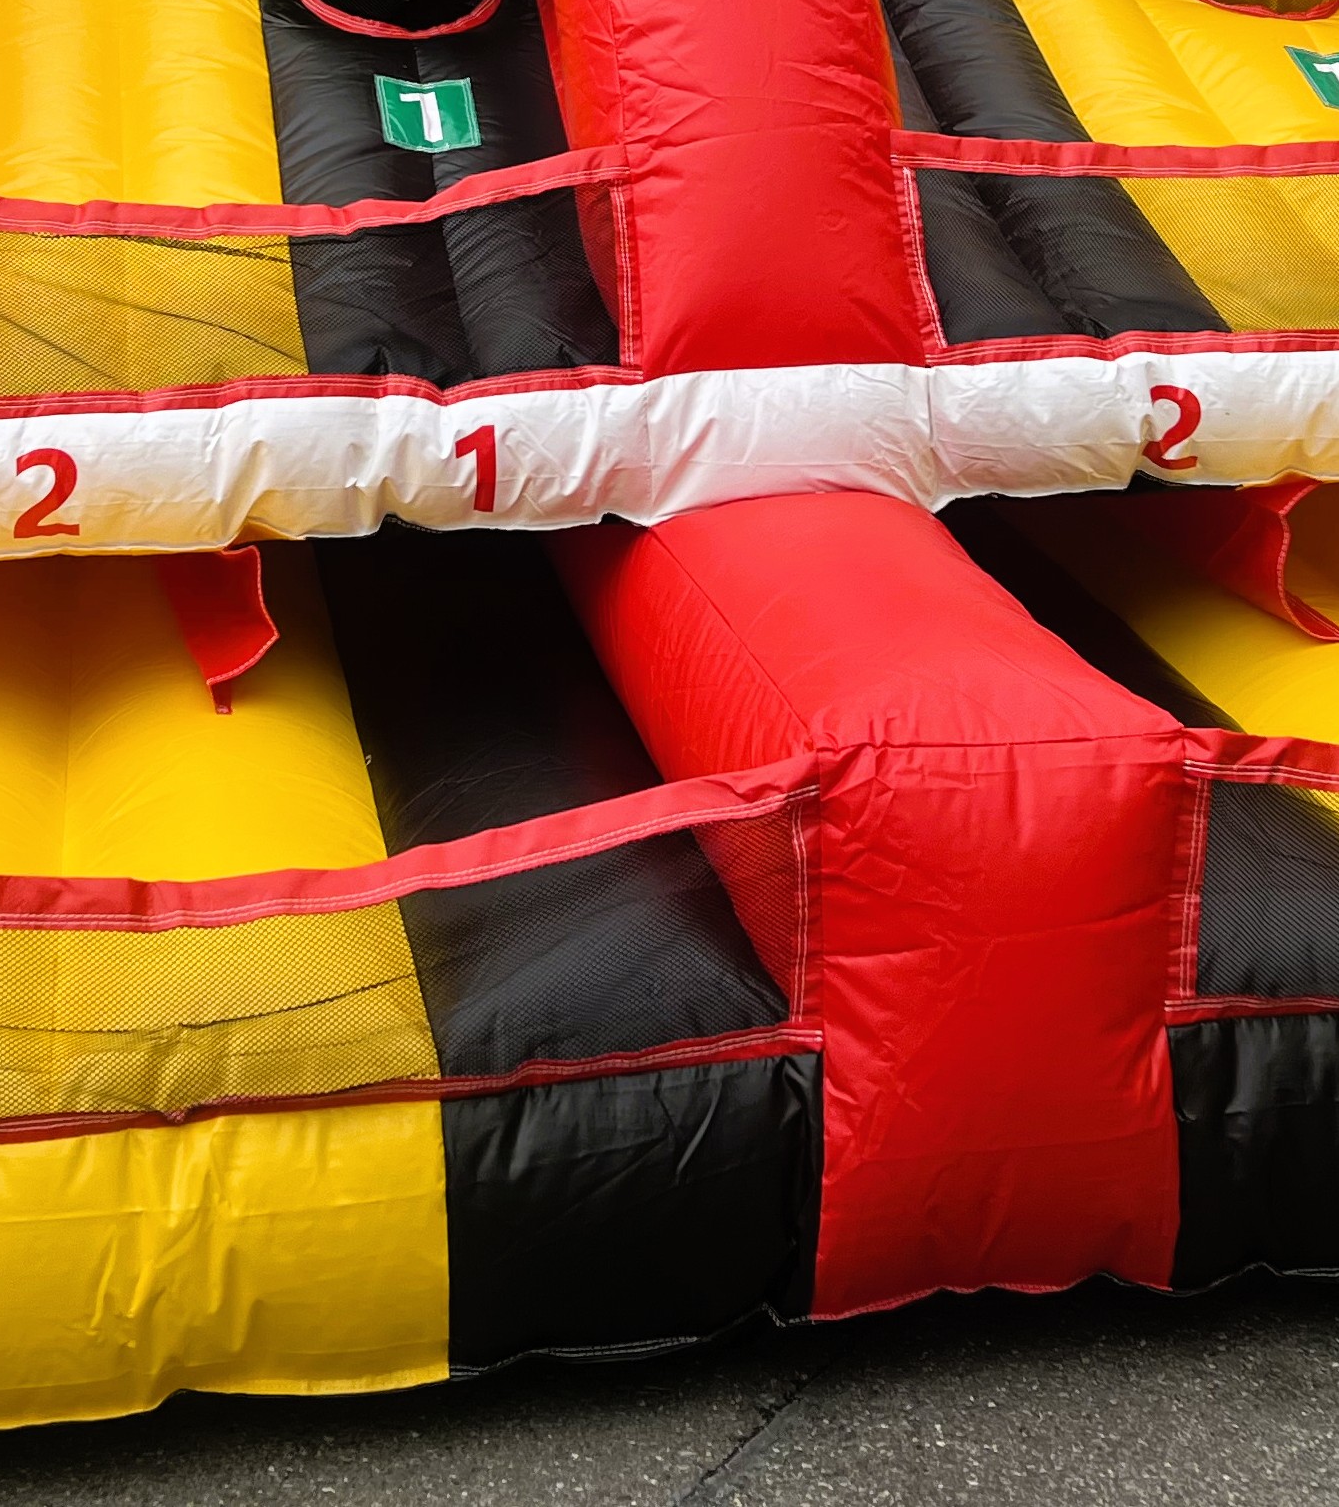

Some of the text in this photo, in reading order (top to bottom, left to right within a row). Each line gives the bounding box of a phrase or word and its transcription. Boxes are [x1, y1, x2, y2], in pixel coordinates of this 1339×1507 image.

[400, 91, 444, 143] 1
[1144, 384, 1202, 471] 2
[13, 425, 497, 539] 2 1
